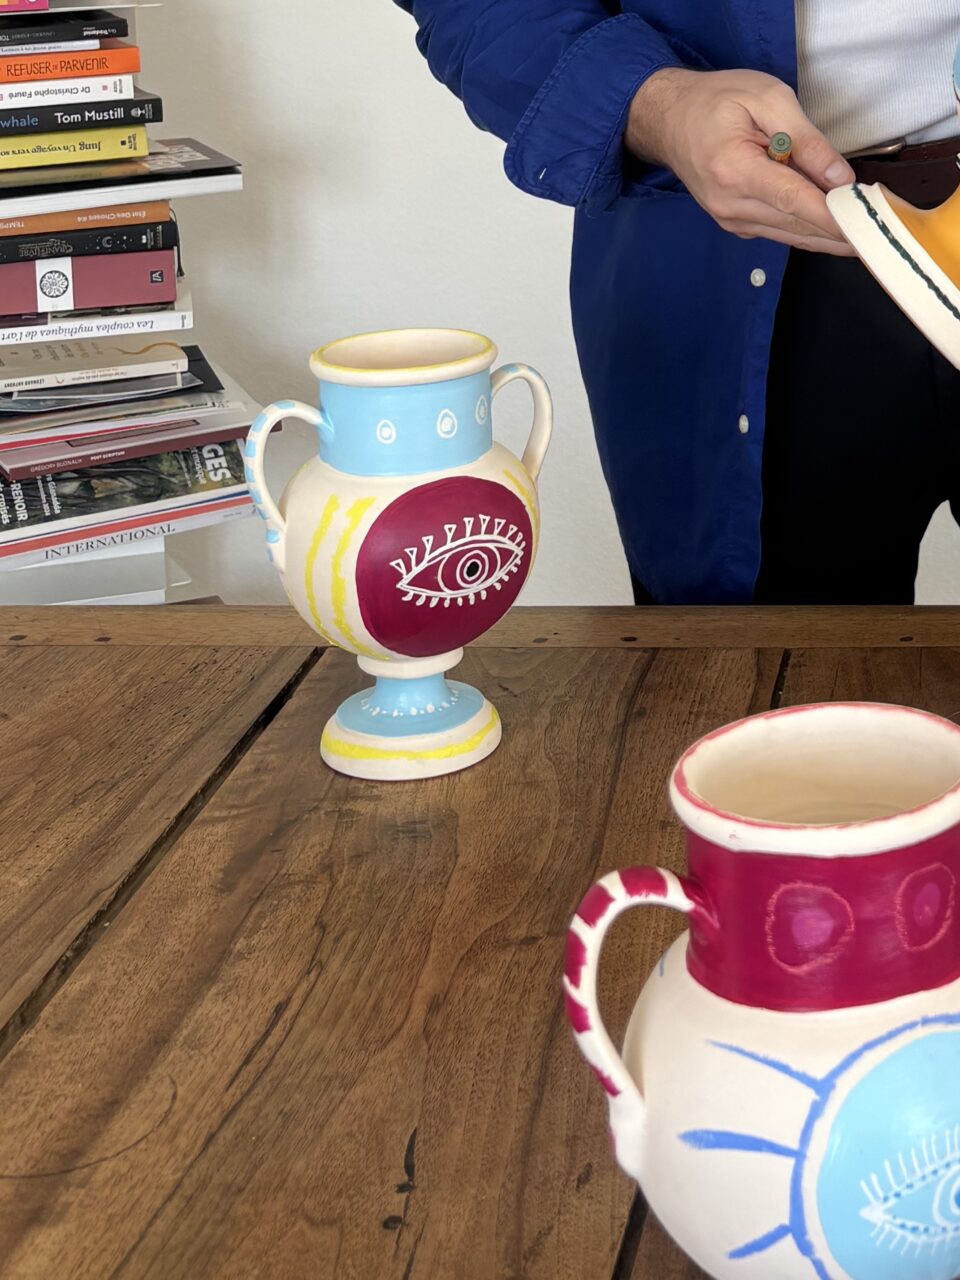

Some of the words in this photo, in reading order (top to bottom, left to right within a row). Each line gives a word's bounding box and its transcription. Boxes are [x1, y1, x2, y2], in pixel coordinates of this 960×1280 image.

[6, 61, 51, 77] REFUSER
[59, 57, 109, 72] PARVENIR
[8, 90, 33, 100] Fauré
[34, 86, 79, 97] Christophe
[81, 86, 91, 94] Dr
[0, 115, 39, 128] whale
[54, 112, 81, 124] Tom
[85, 108, 124, 121] Mustill
[32, 144, 64, 154] voyage
[63, 144, 76, 153] Un
[79, 141, 102, 151] Jung
[11, 148, 31, 156] vers
[97, 322, 135, 331] couples
[137, 320, 154, 329] Les
[25, 331, 38, 339] de
[40, 324, 94, 336] mythiques
[2, 332, 23, 341] l'art
[202, 443, 232, 482] GES
[45, 523, 176, 559] INTERNATIONAL
